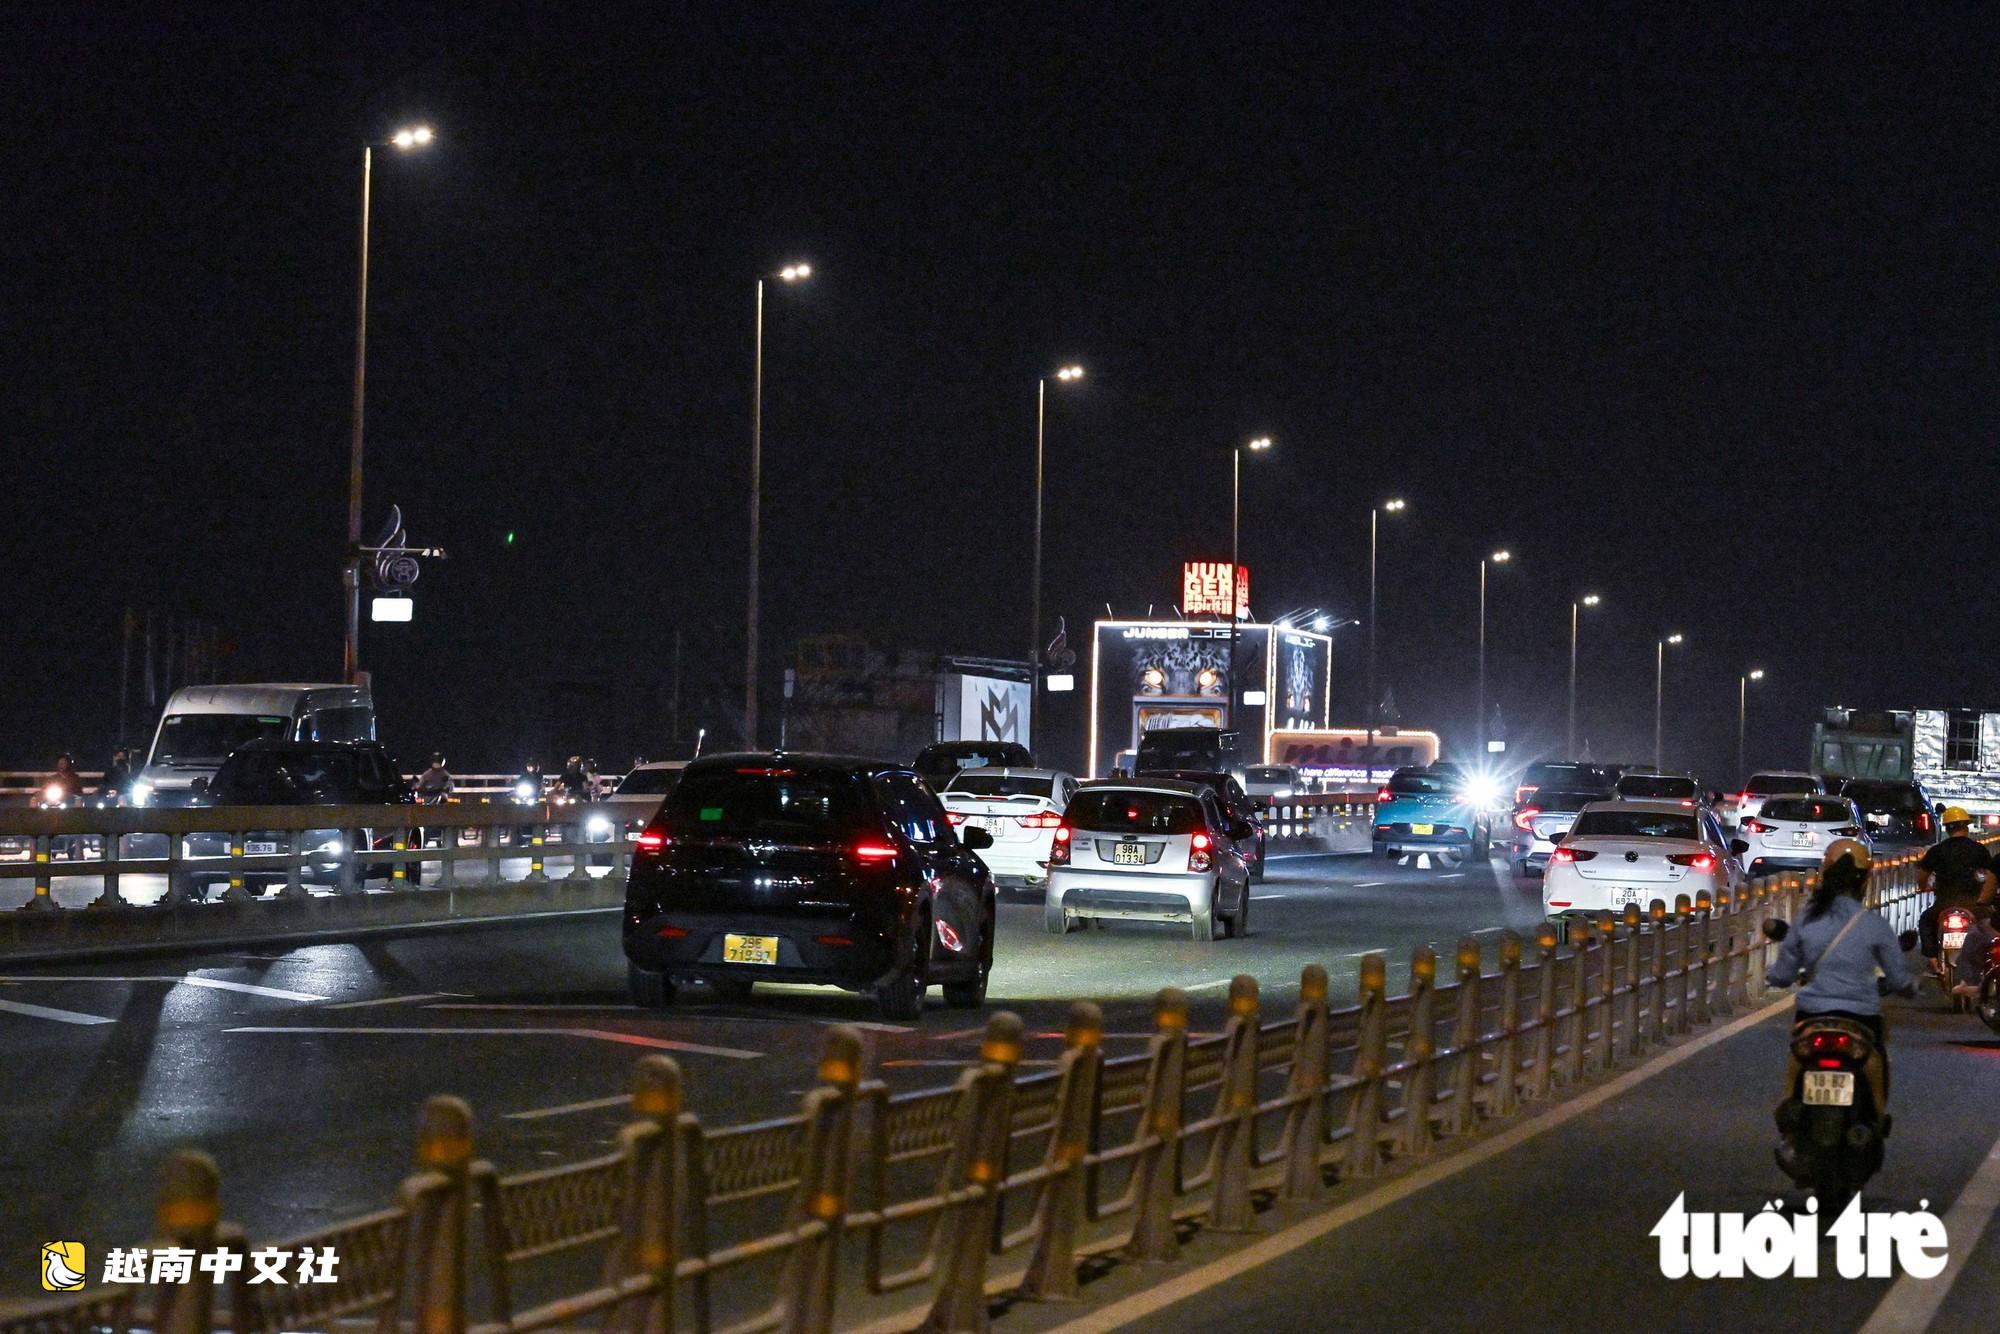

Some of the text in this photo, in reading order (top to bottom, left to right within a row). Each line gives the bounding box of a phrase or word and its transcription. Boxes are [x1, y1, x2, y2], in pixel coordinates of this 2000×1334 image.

[1184, 563, 1233, 579] JUN
[1184, 578, 1233, 596] GER
[1123, 627, 1189, 639] JUNGER
[1122, 844, 1138, 854] 98A
[1622, 890, 1637, 898] 20A
[740, 937, 767, 949] 29E
